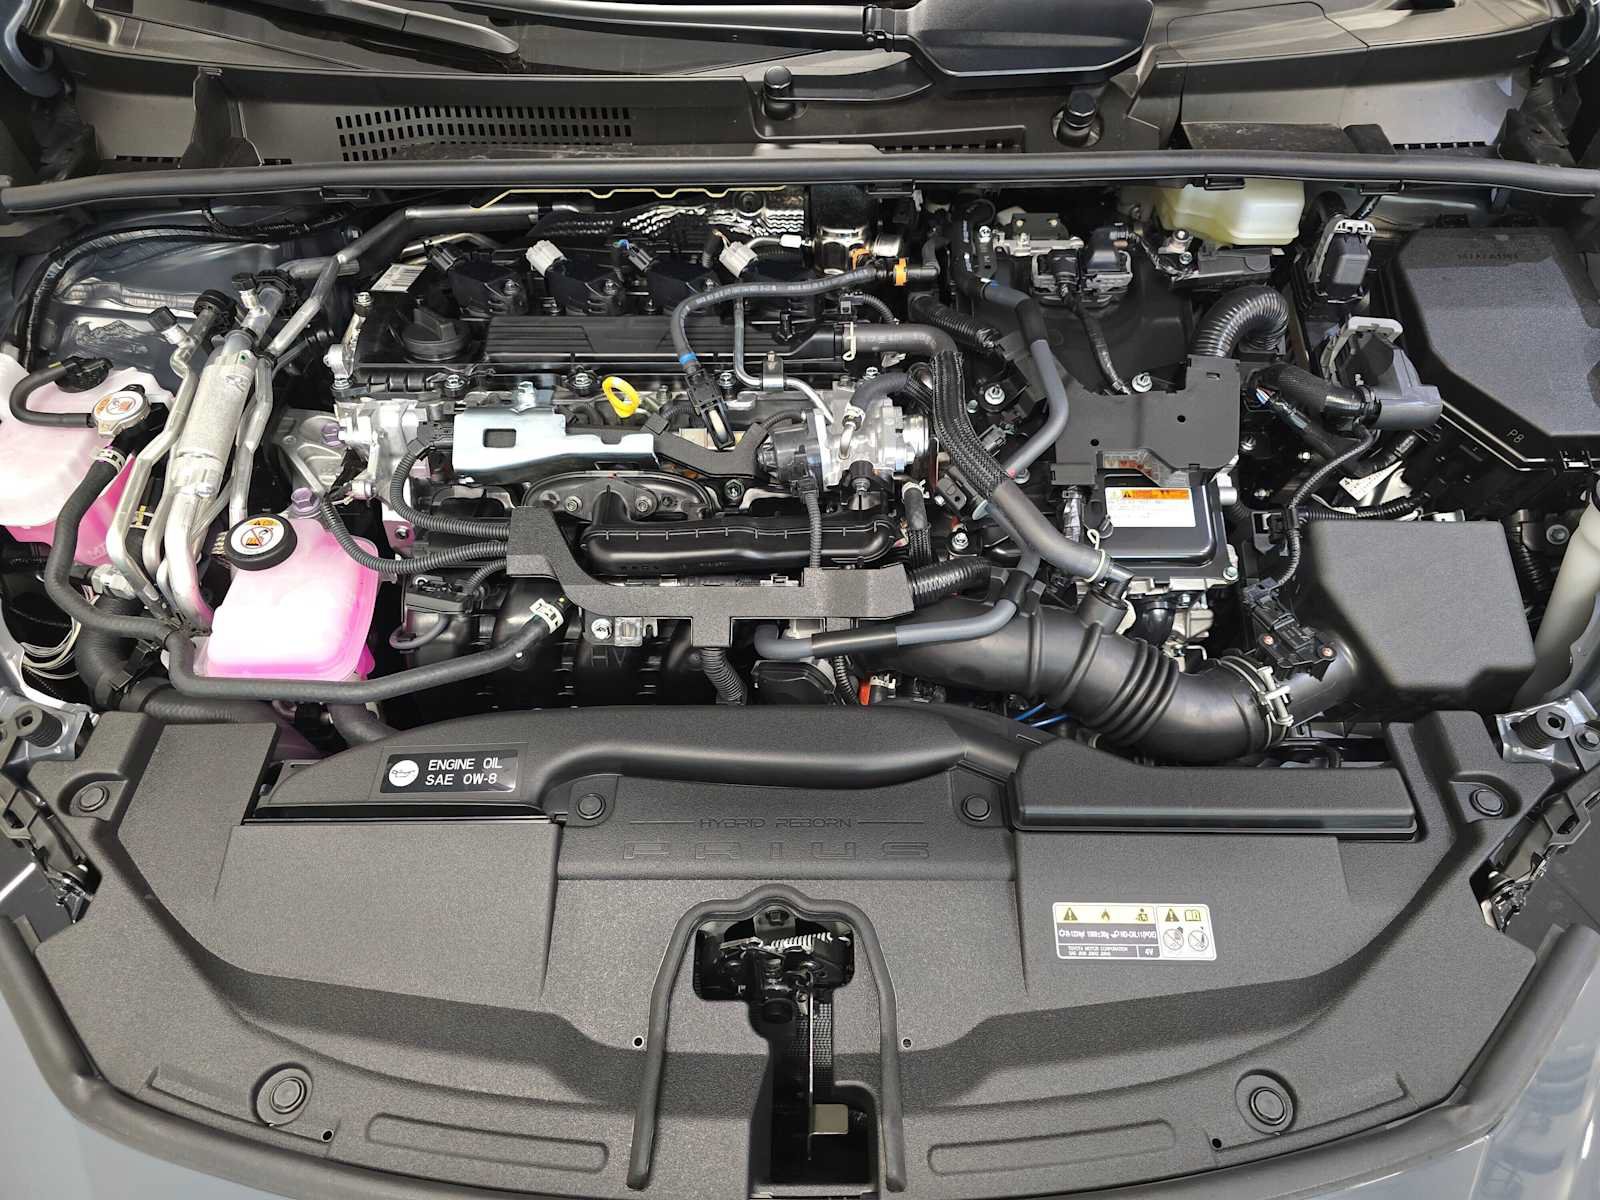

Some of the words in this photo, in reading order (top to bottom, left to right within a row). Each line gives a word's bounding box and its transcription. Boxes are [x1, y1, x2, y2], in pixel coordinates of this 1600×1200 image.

[427, 758, 476, 771] ENGINE
[483, 757, 503, 769] OIL
[425, 773, 455, 786] SAE
[700, 816, 767, 829] HYBRID
[775, 816, 851, 829] REBORN
[622, 841, 930, 860] PRIUS
